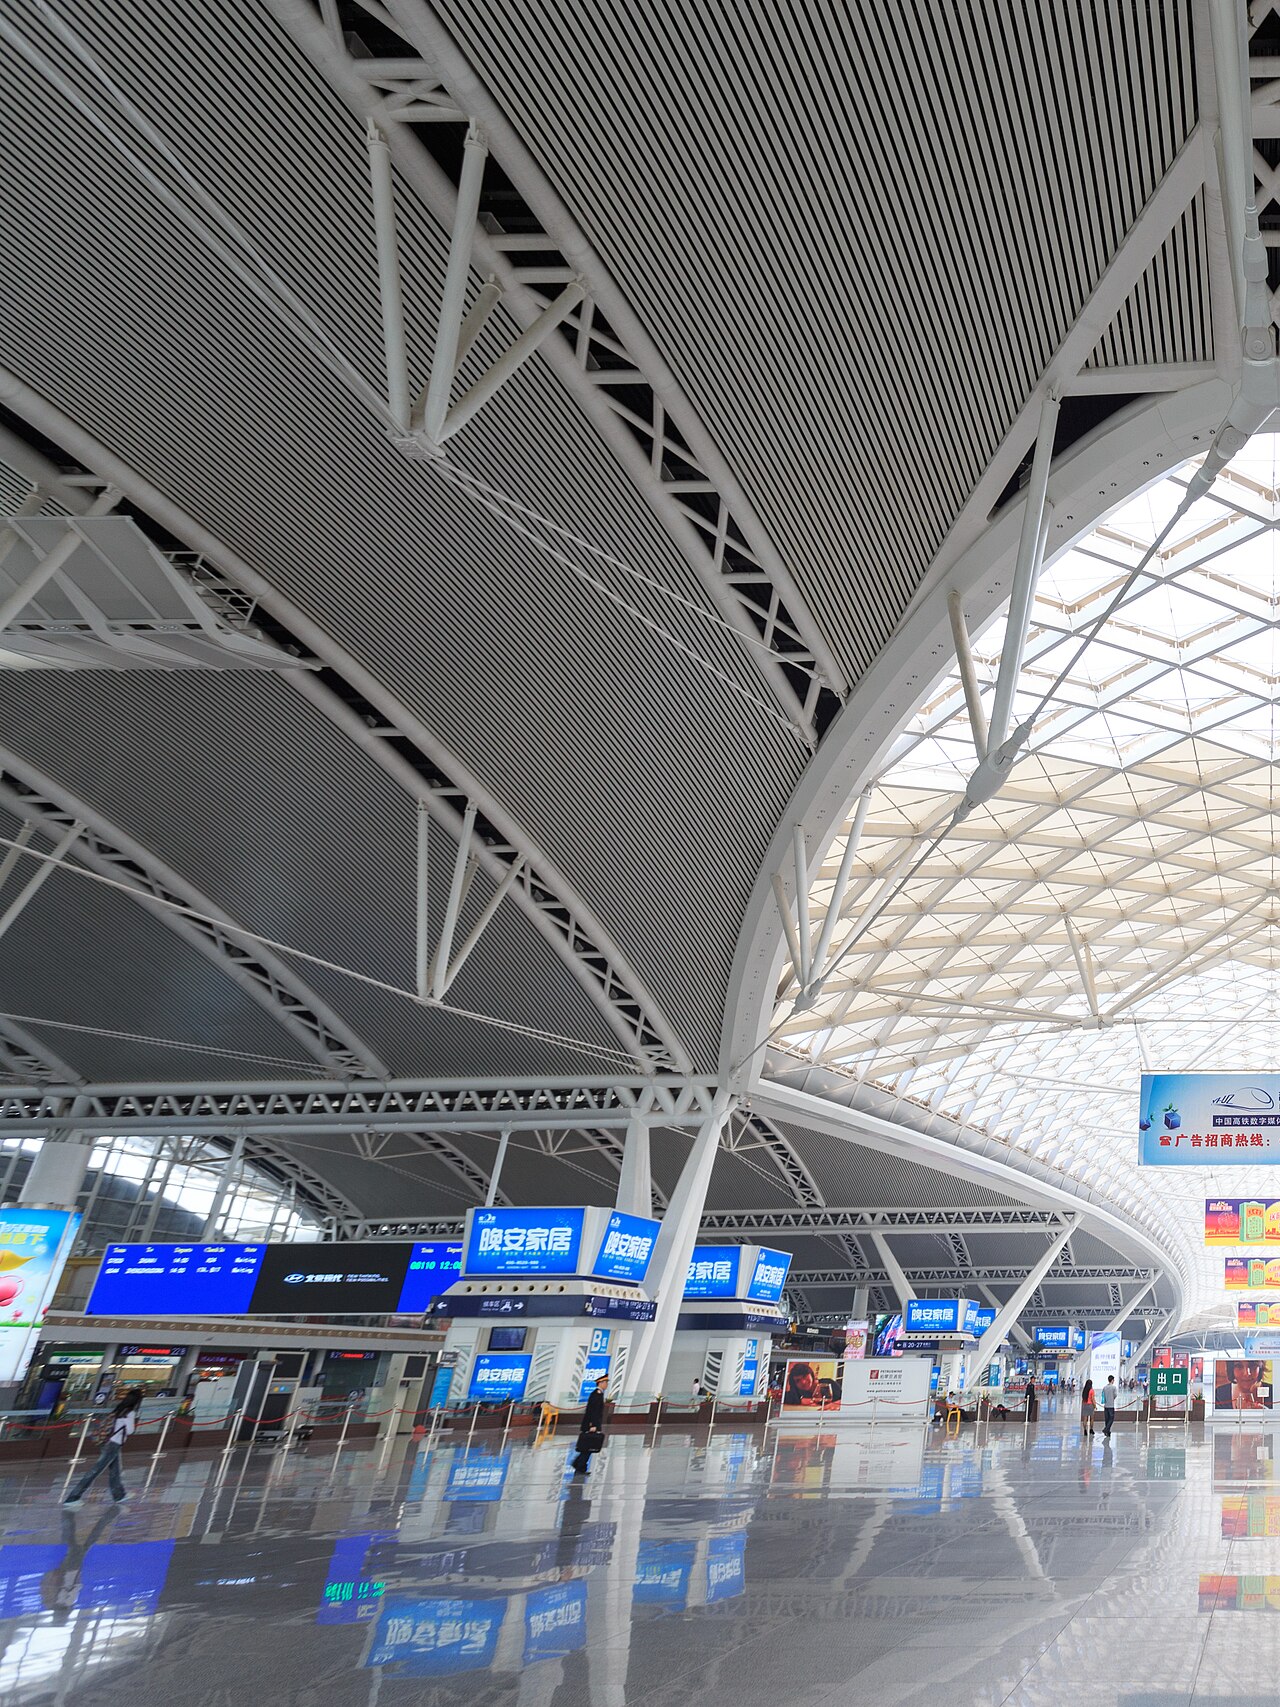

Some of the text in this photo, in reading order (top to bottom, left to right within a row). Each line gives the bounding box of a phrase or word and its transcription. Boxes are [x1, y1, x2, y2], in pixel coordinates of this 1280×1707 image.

[479, 1227, 573, 1252] 晚安家居
[604, 1230, 652, 1261] 晚安家居
[754, 1263, 785, 1286] 晚安家居
[911, 1308, 953, 1321] 晚安家居
[476, 1368, 525, 1382] 晚安家居
[1157, 1372, 1182, 1385] 出口
